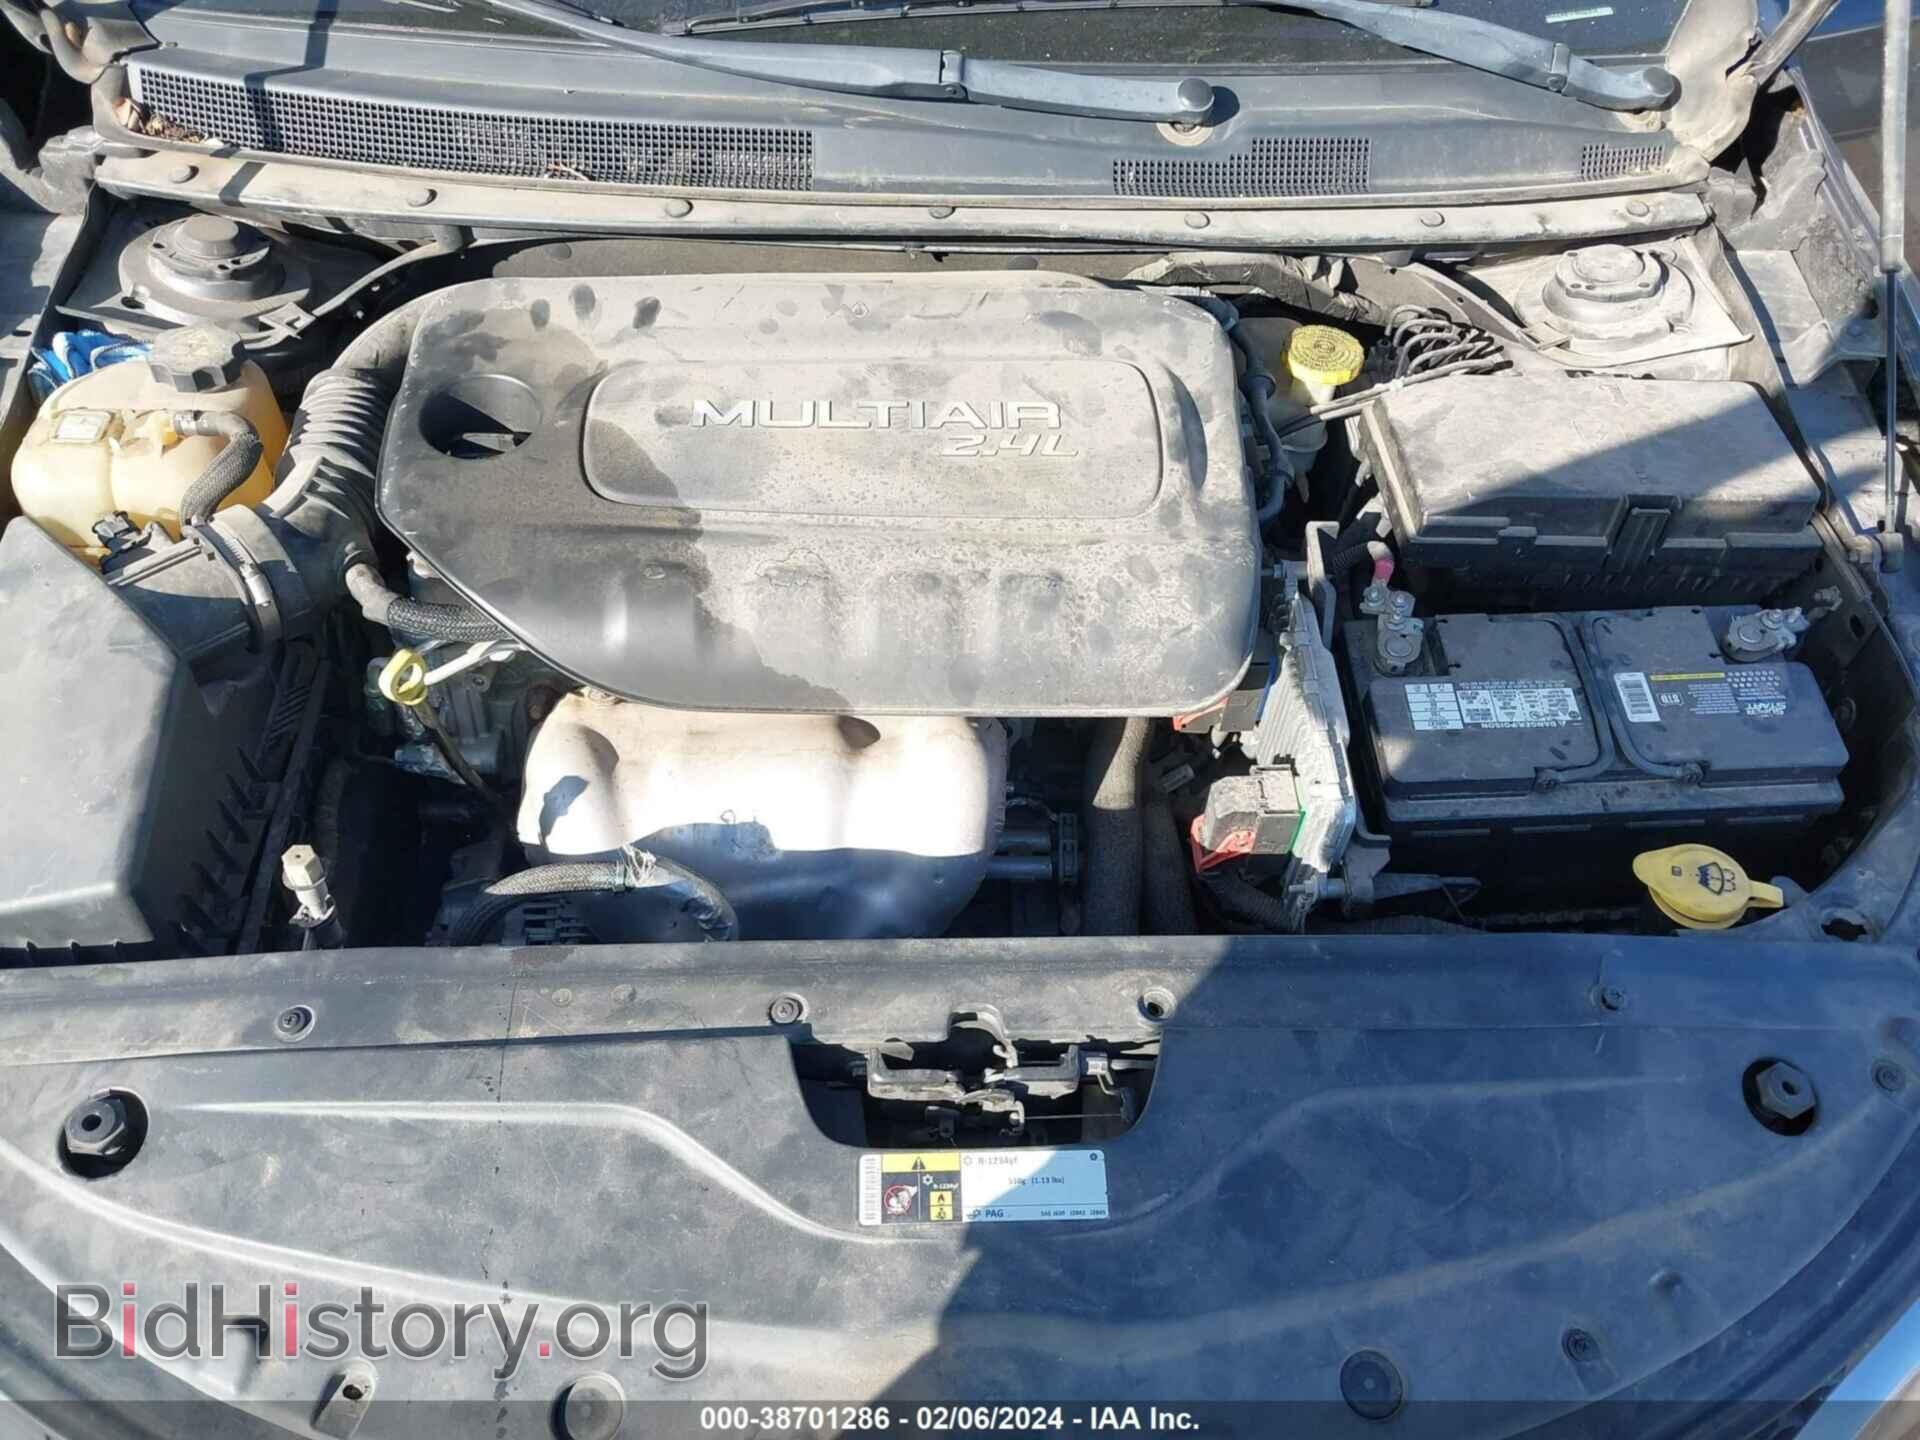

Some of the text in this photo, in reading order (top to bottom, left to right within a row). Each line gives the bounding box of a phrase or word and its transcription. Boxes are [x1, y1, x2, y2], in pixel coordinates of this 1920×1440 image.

[690, 399, 1062, 429] MULTIAIR
[939, 432, 1080, 457] 2.4L
[985, 1208, 1004, 1218] PAG
